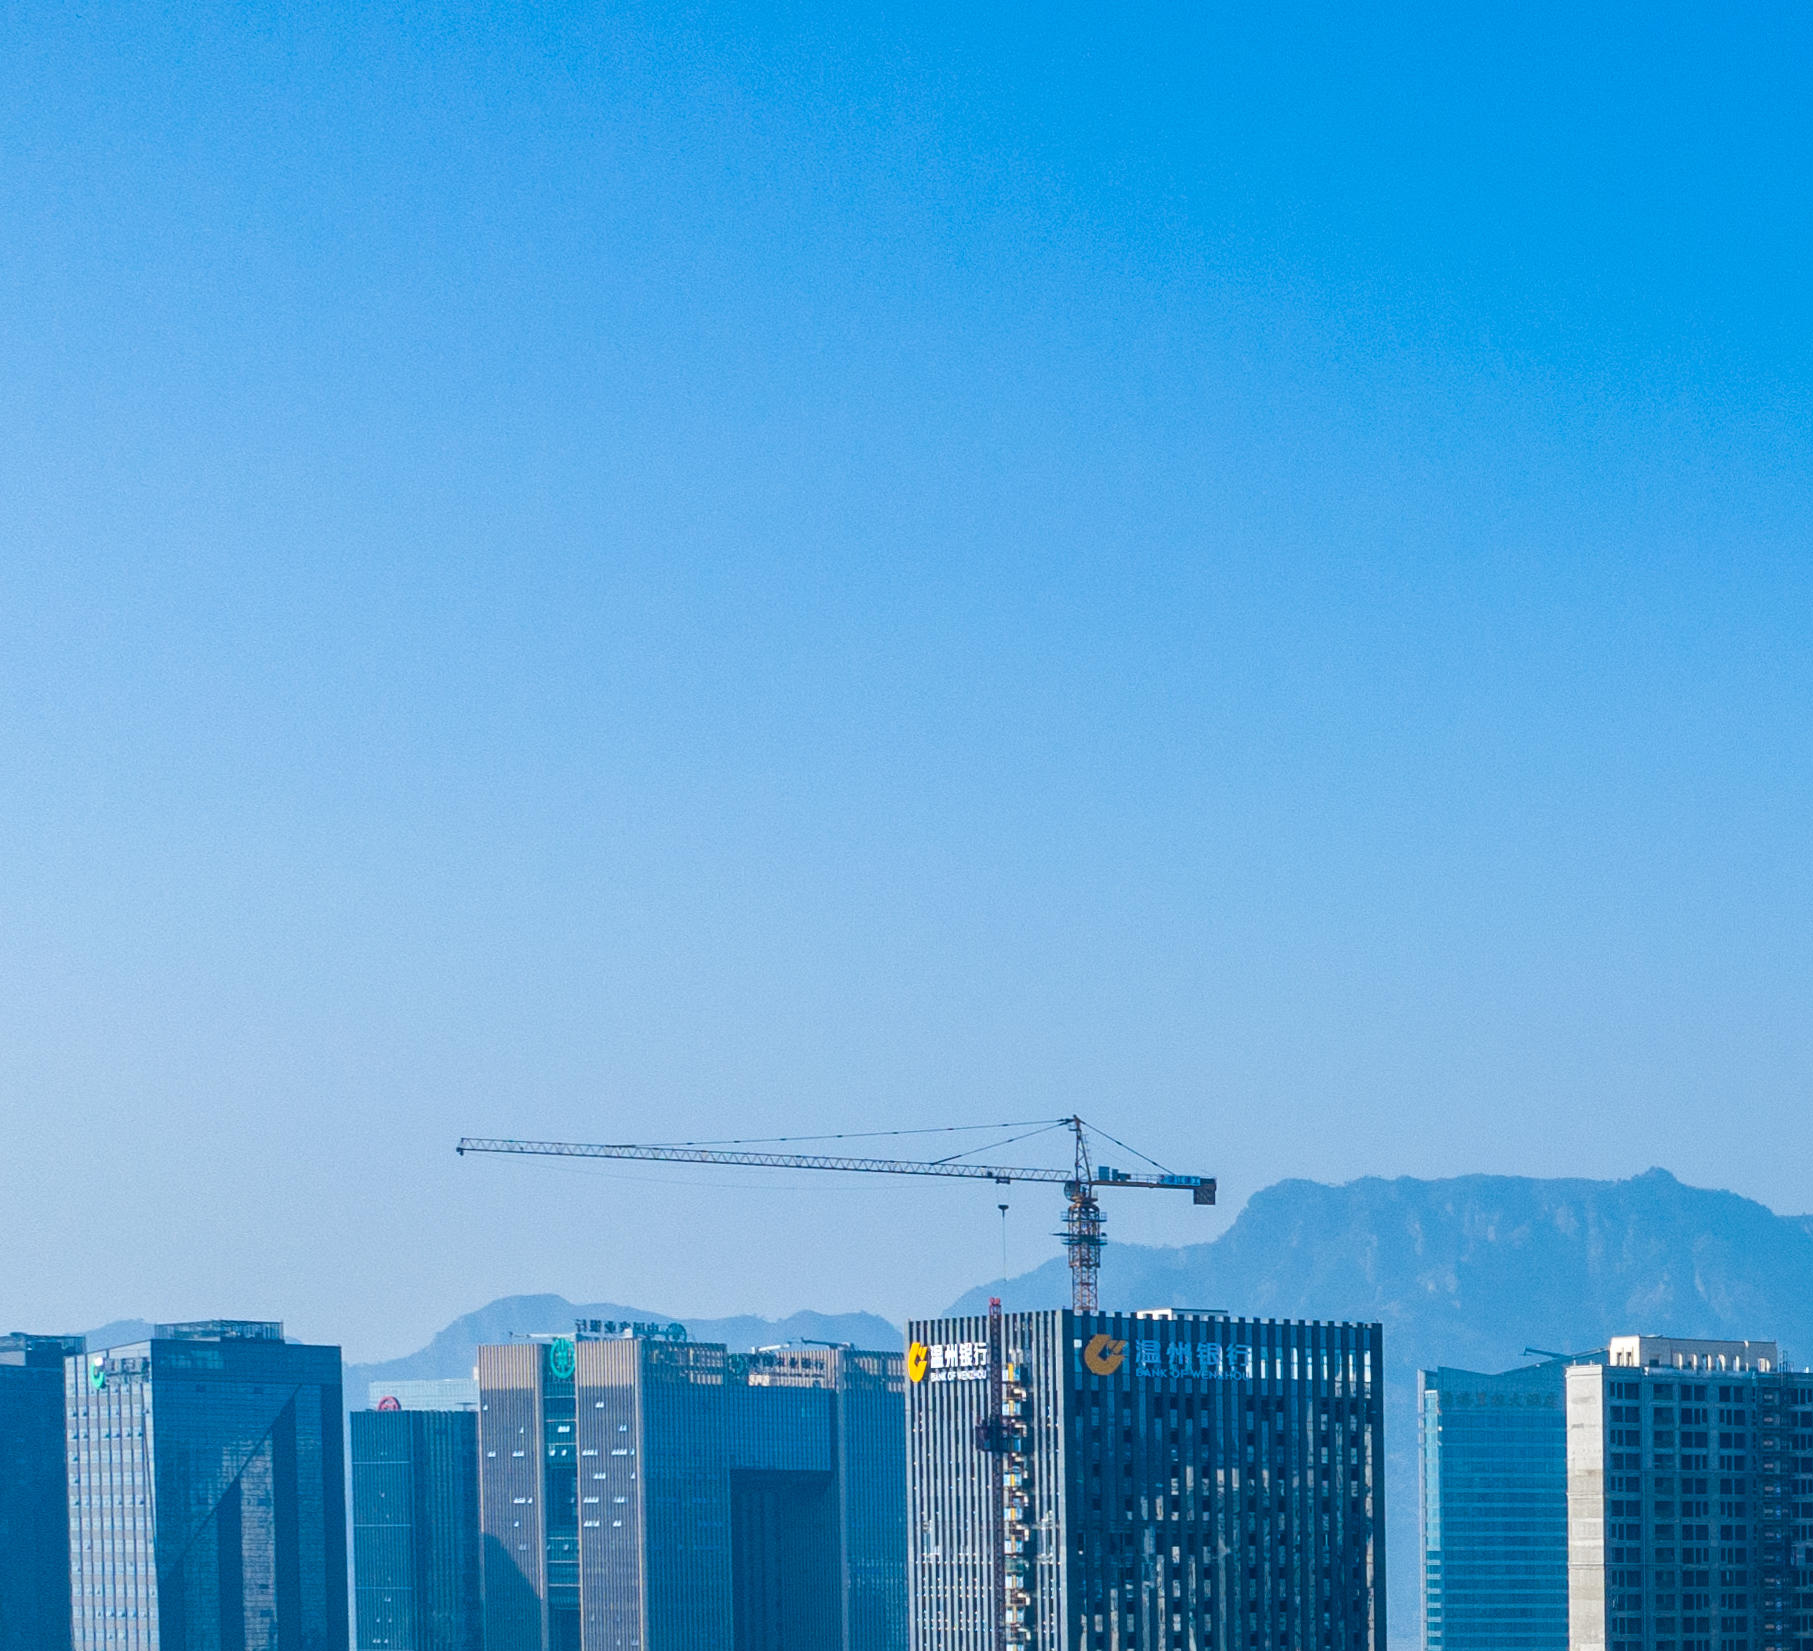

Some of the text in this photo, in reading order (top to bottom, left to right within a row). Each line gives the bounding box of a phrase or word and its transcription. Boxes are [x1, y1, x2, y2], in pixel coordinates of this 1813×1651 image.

[930, 1343, 987, 1368] 温州银行
[1136, 1339, 1251, 1367] 温州银行
[930, 1372, 947, 1382] BANK
[947, 1371, 957, 1382] OF
[1136, 1368, 1167, 1377] BANK
[1177, 1369, 1188, 1378] OF
